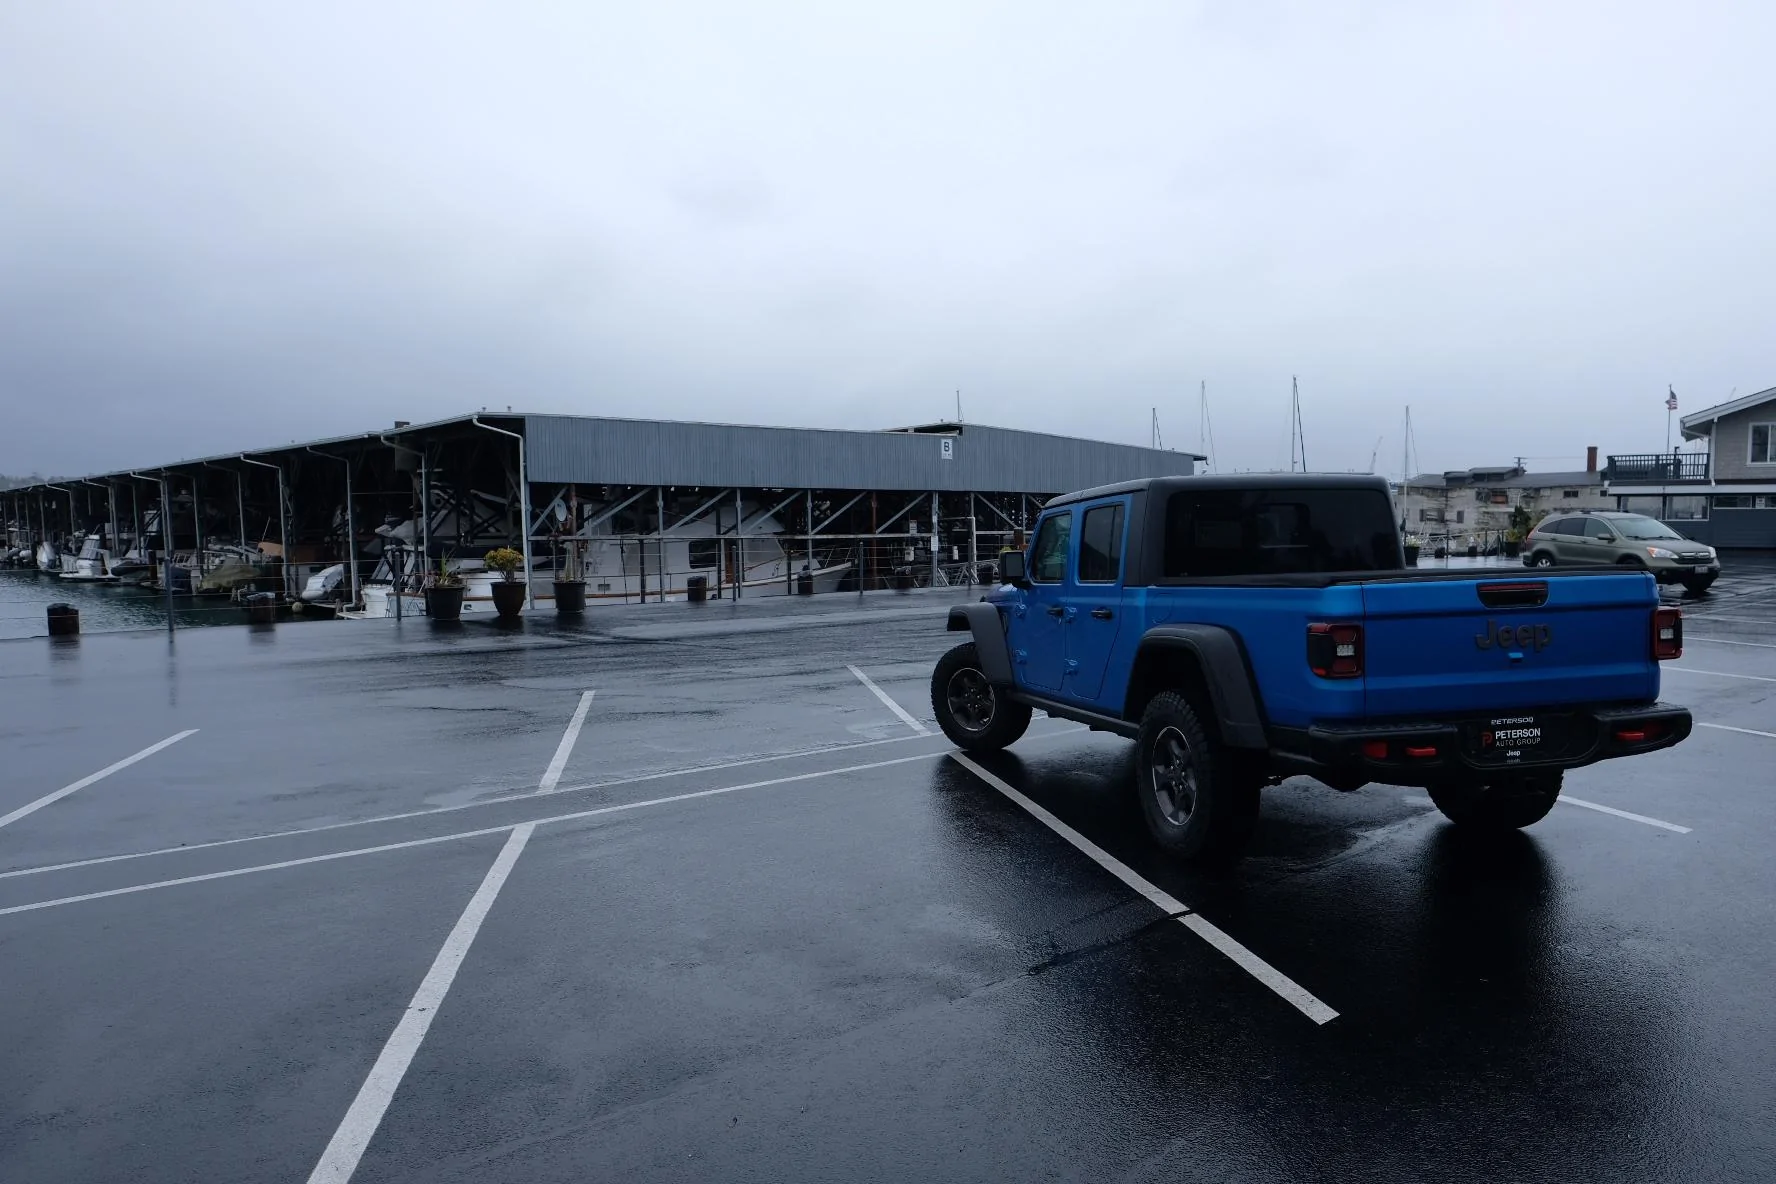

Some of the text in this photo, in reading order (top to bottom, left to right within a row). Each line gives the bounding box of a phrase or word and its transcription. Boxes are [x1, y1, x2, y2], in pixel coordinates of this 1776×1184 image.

[944, 441, 950, 452] B
[1475, 618, 1552, 653] Jeep
[1495, 727, 1541, 740] PETERSON
[1516, 737, 1541, 746] GROUP
[1506, 749, 1521, 757] Jeep
